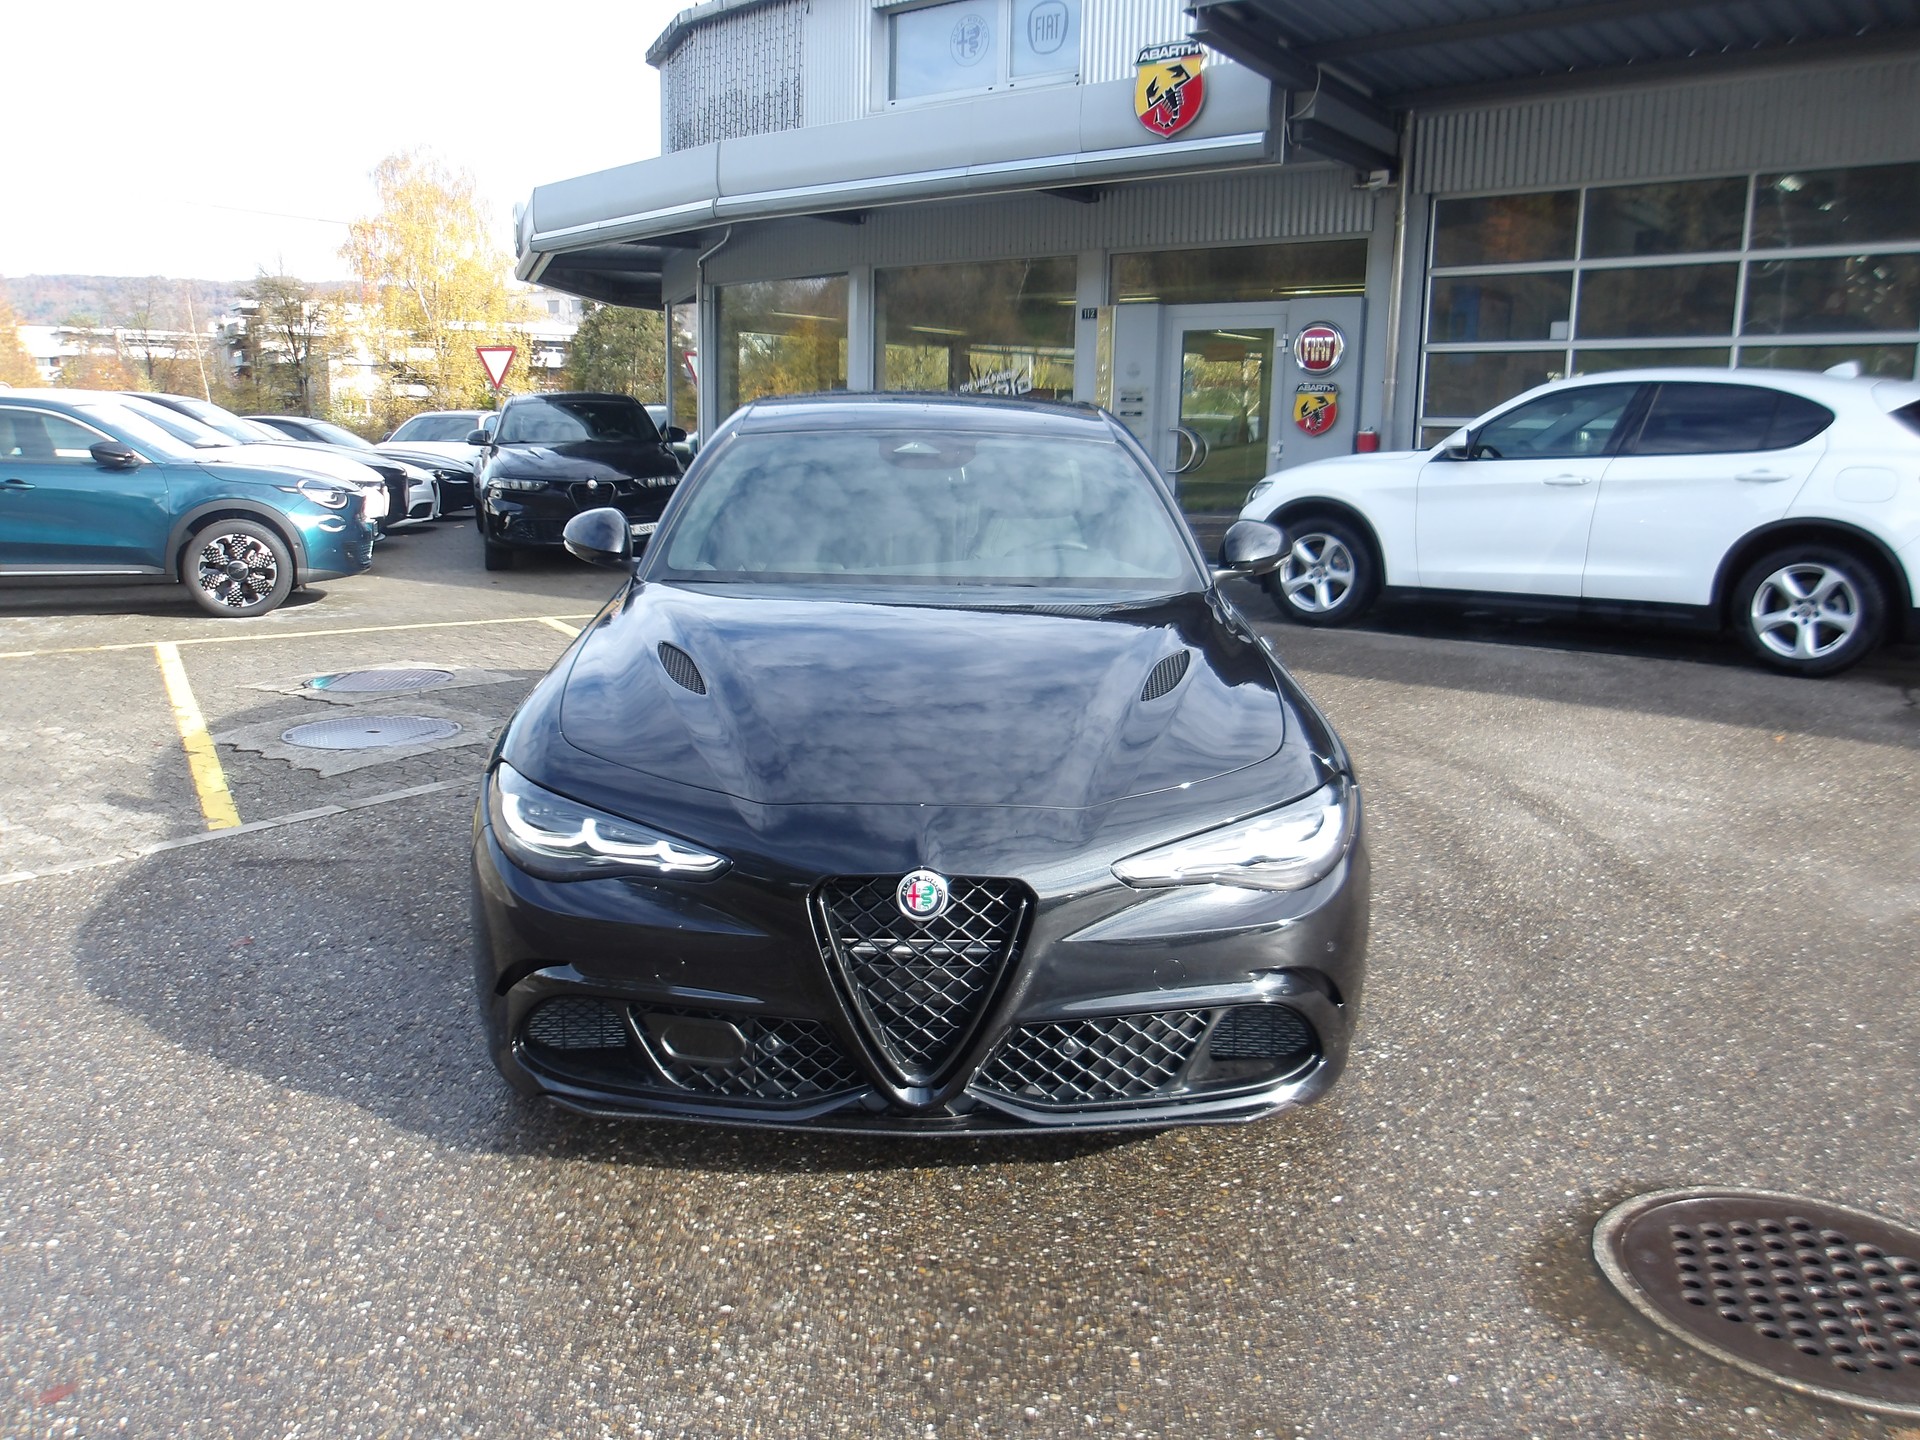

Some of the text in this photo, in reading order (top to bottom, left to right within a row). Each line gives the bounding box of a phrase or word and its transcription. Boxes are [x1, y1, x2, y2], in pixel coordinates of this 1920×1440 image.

[1035, 13, 1061, 42] FIAT
[1139, 43, 1199, 62] ABARTH
[1084, 308, 1096, 318] 112
[1304, 337, 1334, 361] FIAT
[1298, 384, 1335, 392] ABARTH
[920, 875, 943, 898] OMO
